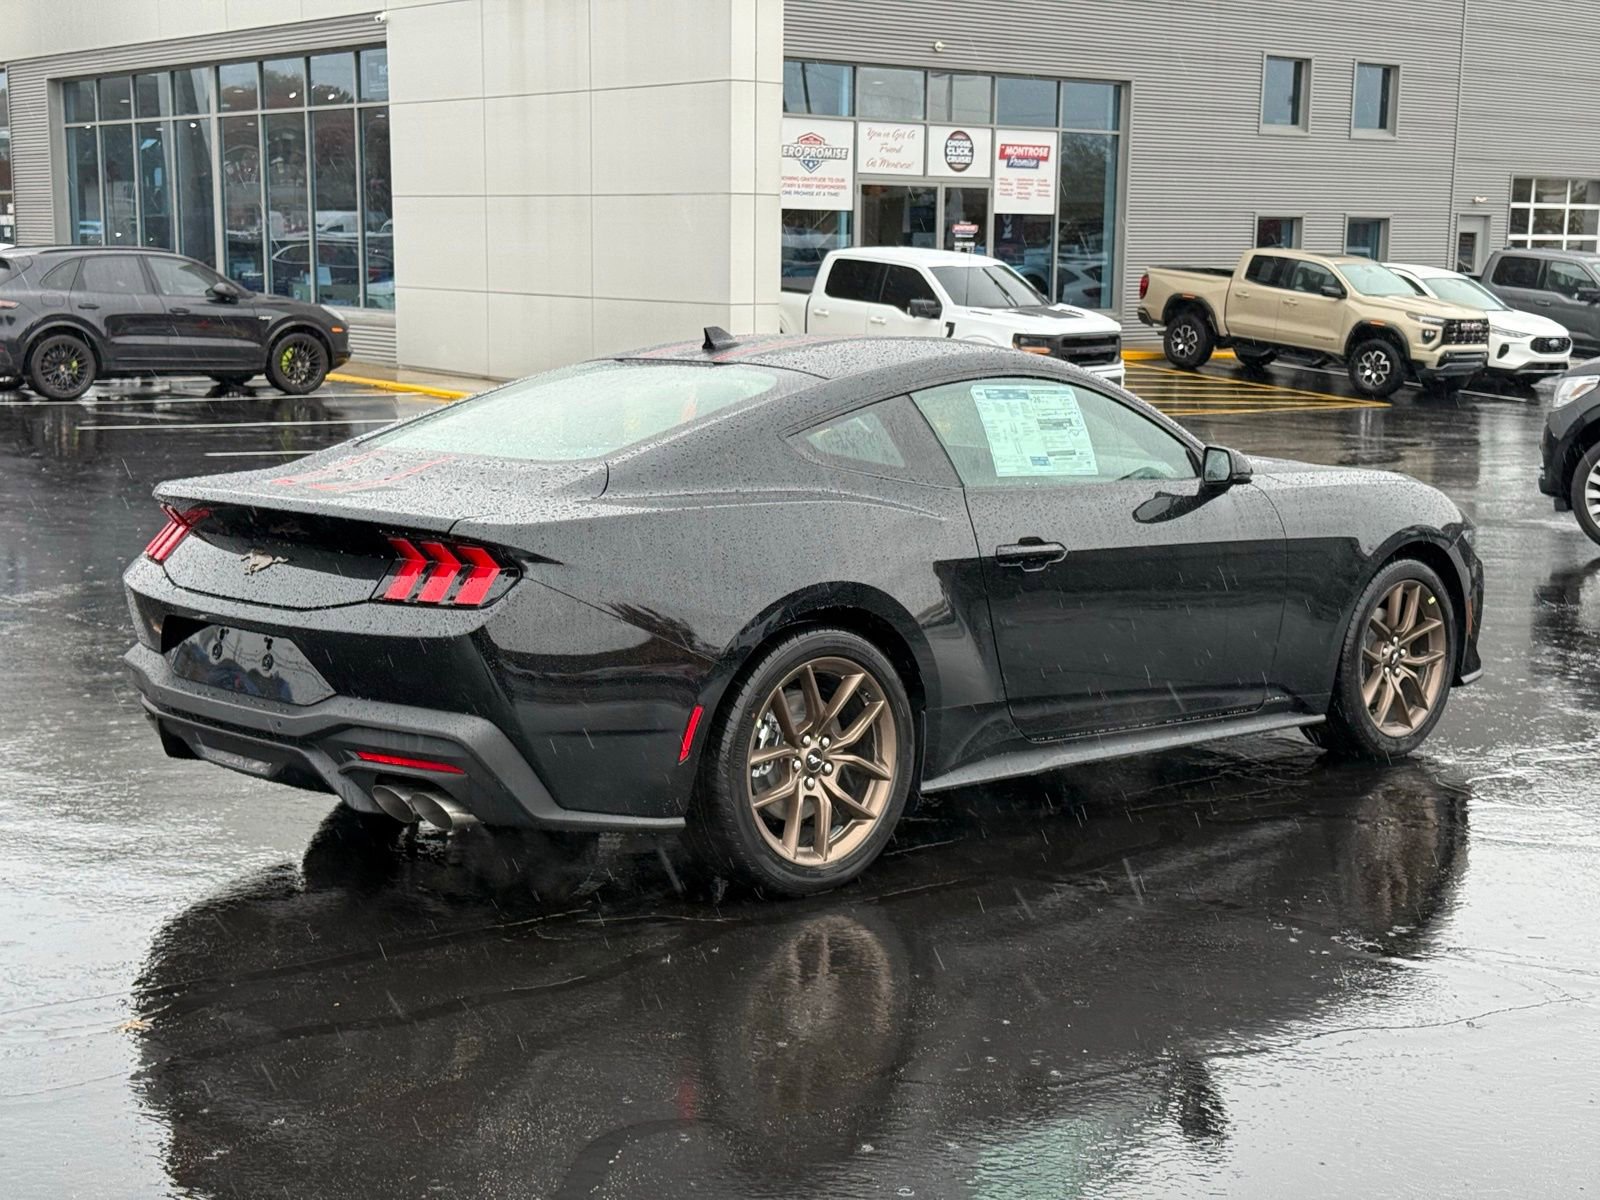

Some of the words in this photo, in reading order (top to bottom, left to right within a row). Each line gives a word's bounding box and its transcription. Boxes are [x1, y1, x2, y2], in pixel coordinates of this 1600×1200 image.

[782, 146, 803, 157] ERO
[803, 147, 848, 160] PROMISE
[1004, 146, 1049, 158] MONTROSE
